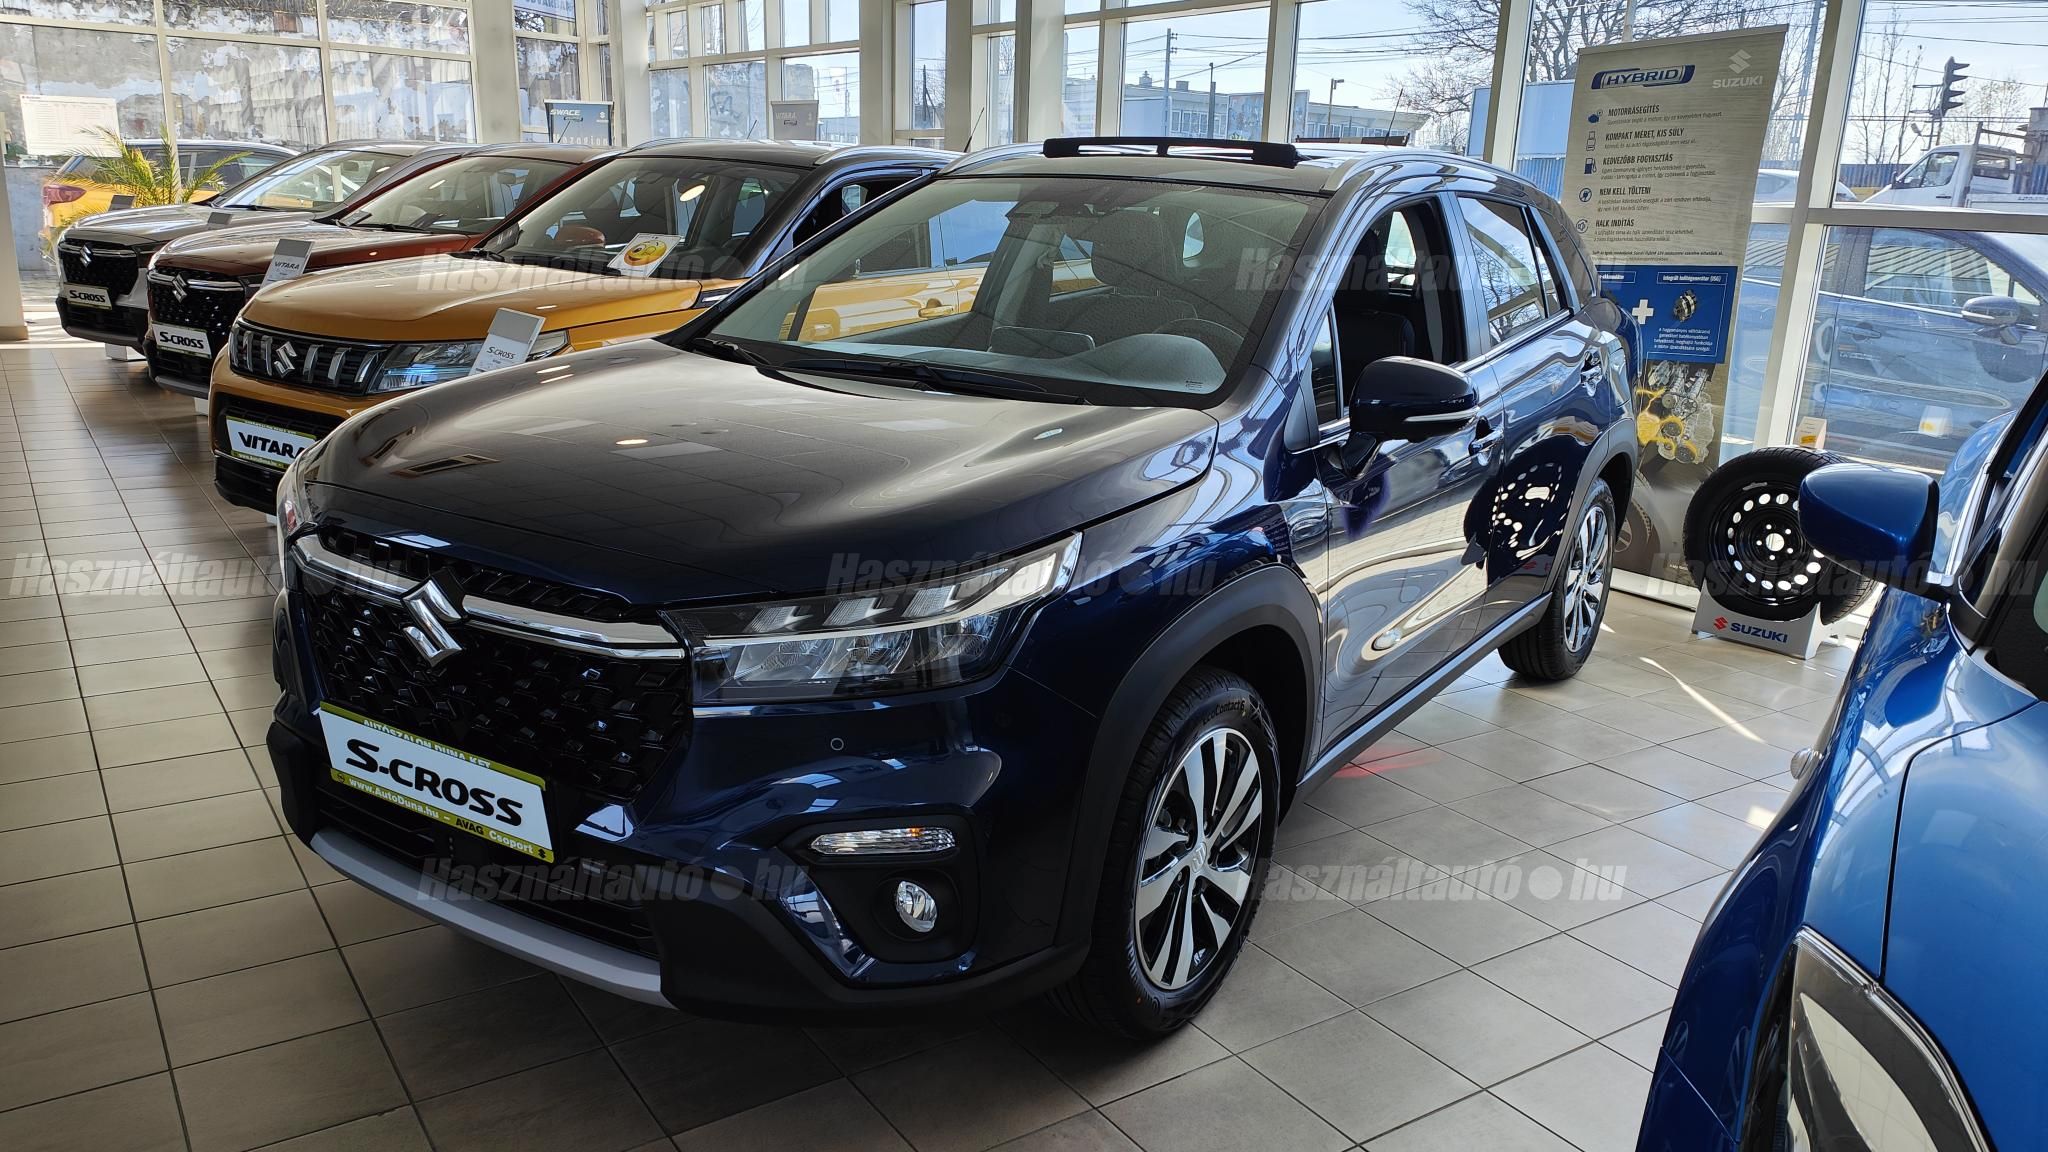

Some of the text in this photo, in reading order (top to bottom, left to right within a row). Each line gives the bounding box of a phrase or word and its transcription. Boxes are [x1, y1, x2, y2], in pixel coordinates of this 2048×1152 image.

[1606, 69, 1679, 86] HYBRID
[1712, 75, 1764, 89] SUZUKI
[1605, 131, 1633, 141] KOMPAKT
[1657, 129, 1667, 138] KIS
[1599, 188, 1612, 196] NEM
[1612, 187, 1627, 196] KELL
[1595, 219, 1610, 228] HALK
[274, 261, 300, 270] VITARA
[69, 290, 106, 303] S-CROSS
[159, 331, 204, 349] S-CROSS
[486, 346, 516, 360] S-CROSS
[1730, 622, 1788, 643] SUZUKI
[345, 738, 523, 827] S-CROSS
[348, 776, 439, 821] www.AutoDuna.hu
[455, 818, 485, 836] AVAG
[489, 830, 534, 855] Csoport
